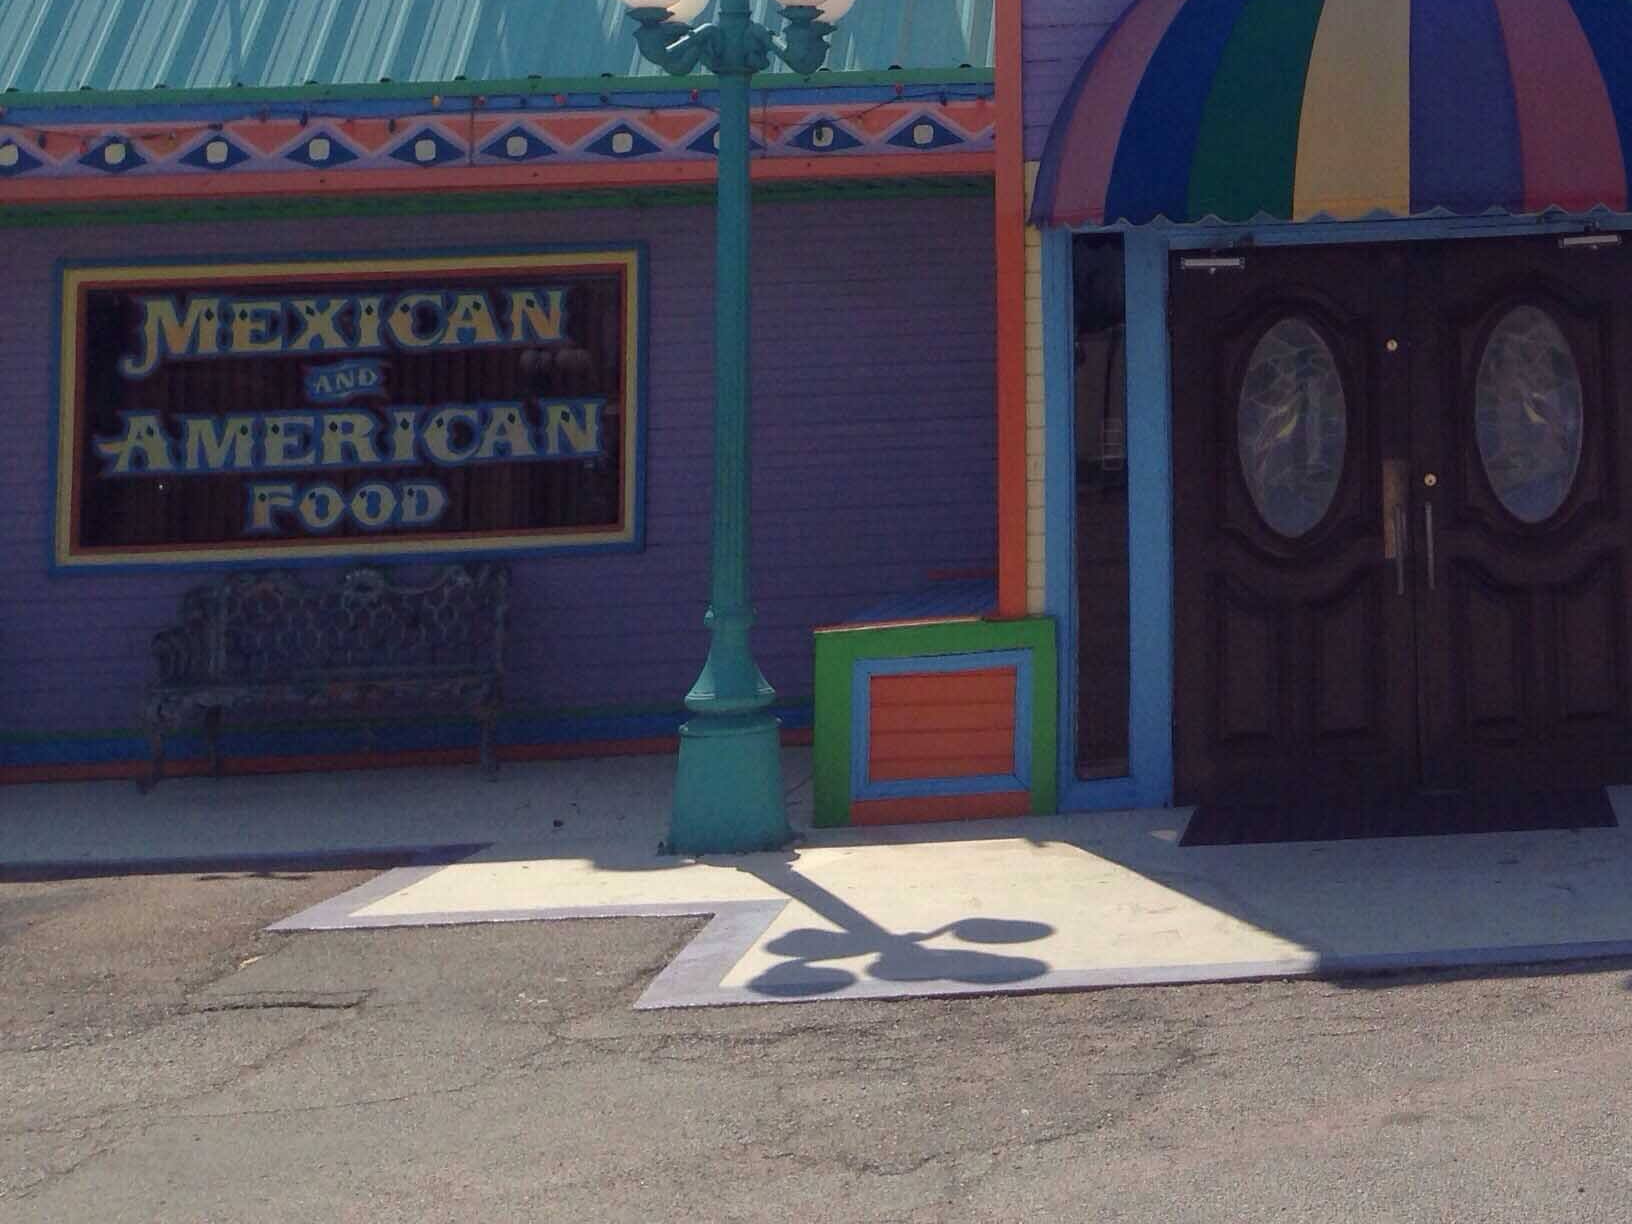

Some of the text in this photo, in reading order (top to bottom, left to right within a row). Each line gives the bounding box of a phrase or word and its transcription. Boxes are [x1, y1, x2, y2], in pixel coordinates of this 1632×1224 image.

[122, 288, 567, 378] MEXICAN
[312, 364, 379, 396] AND
[97, 402, 602, 472] AMERICAN
[248, 484, 445, 530] FOOD
